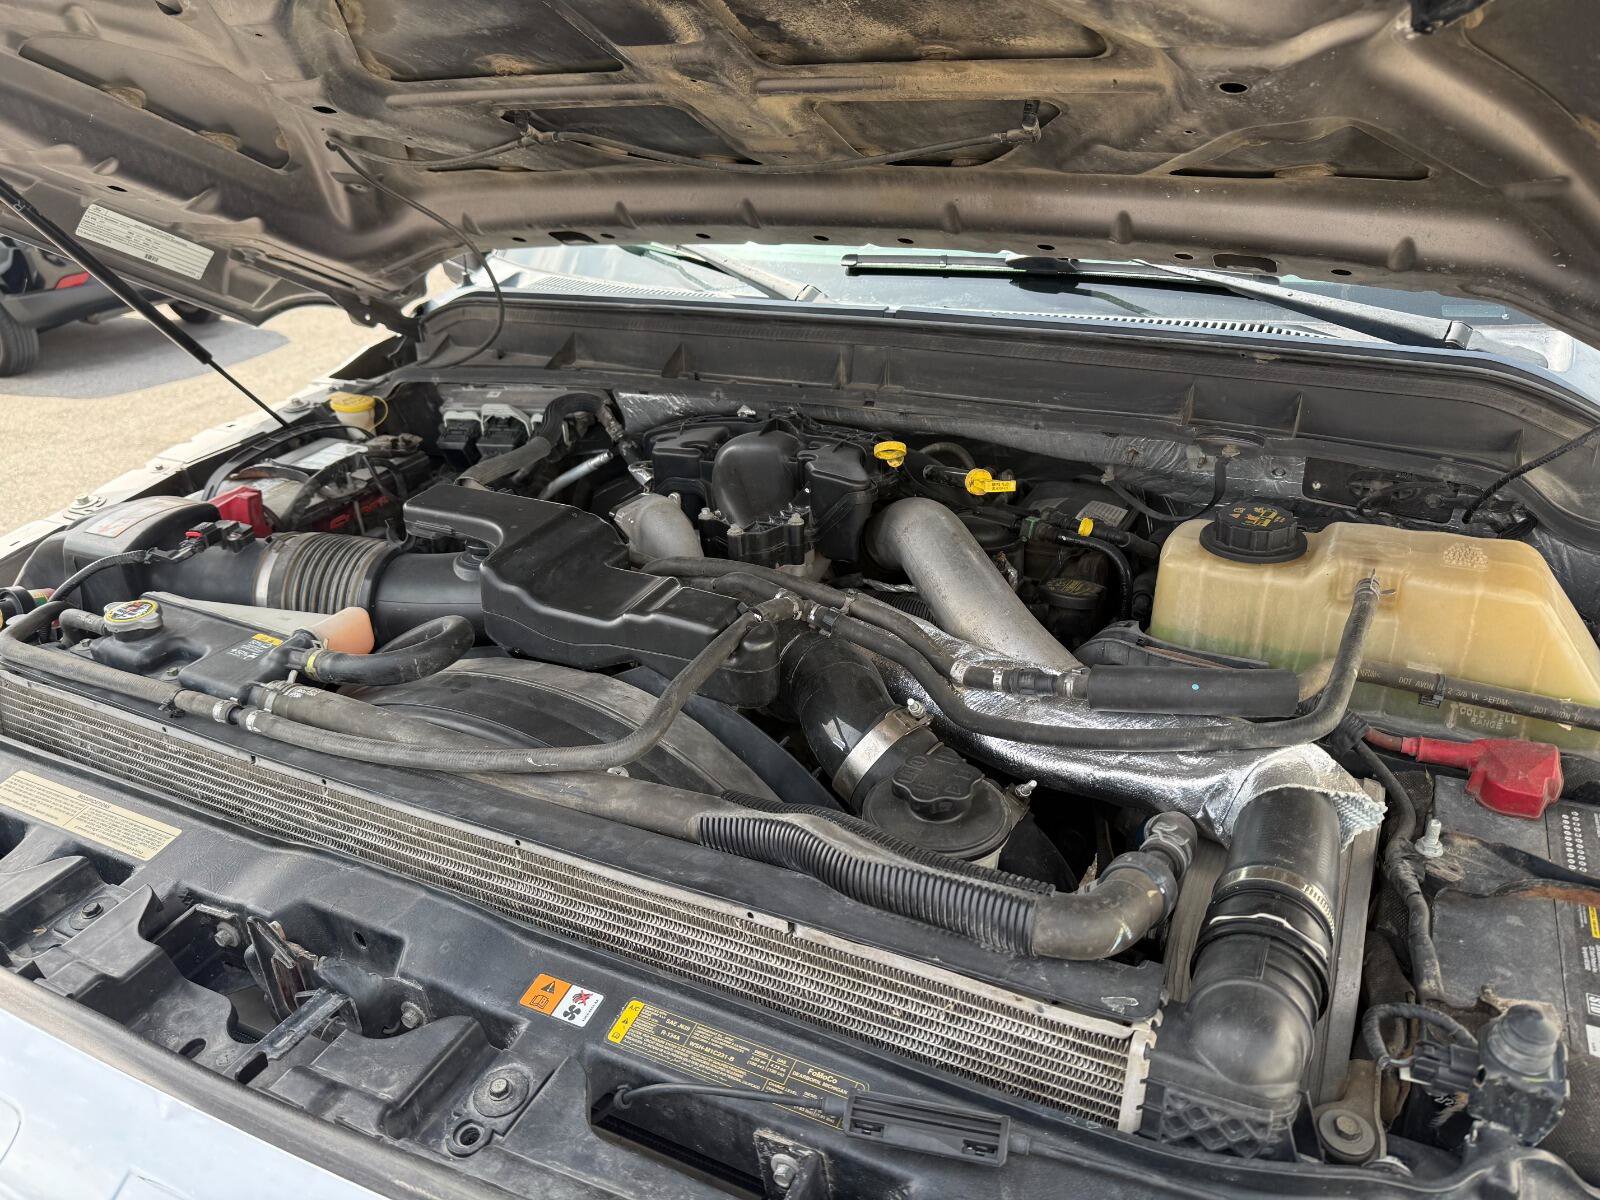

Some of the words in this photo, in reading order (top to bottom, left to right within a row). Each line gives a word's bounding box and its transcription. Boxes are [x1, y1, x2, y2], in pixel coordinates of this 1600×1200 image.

[1459, 705, 1486, 718] COLD
[1470, 717, 1503, 730] RANGE
[807, 1068, 838, 1084] FoMoCo
